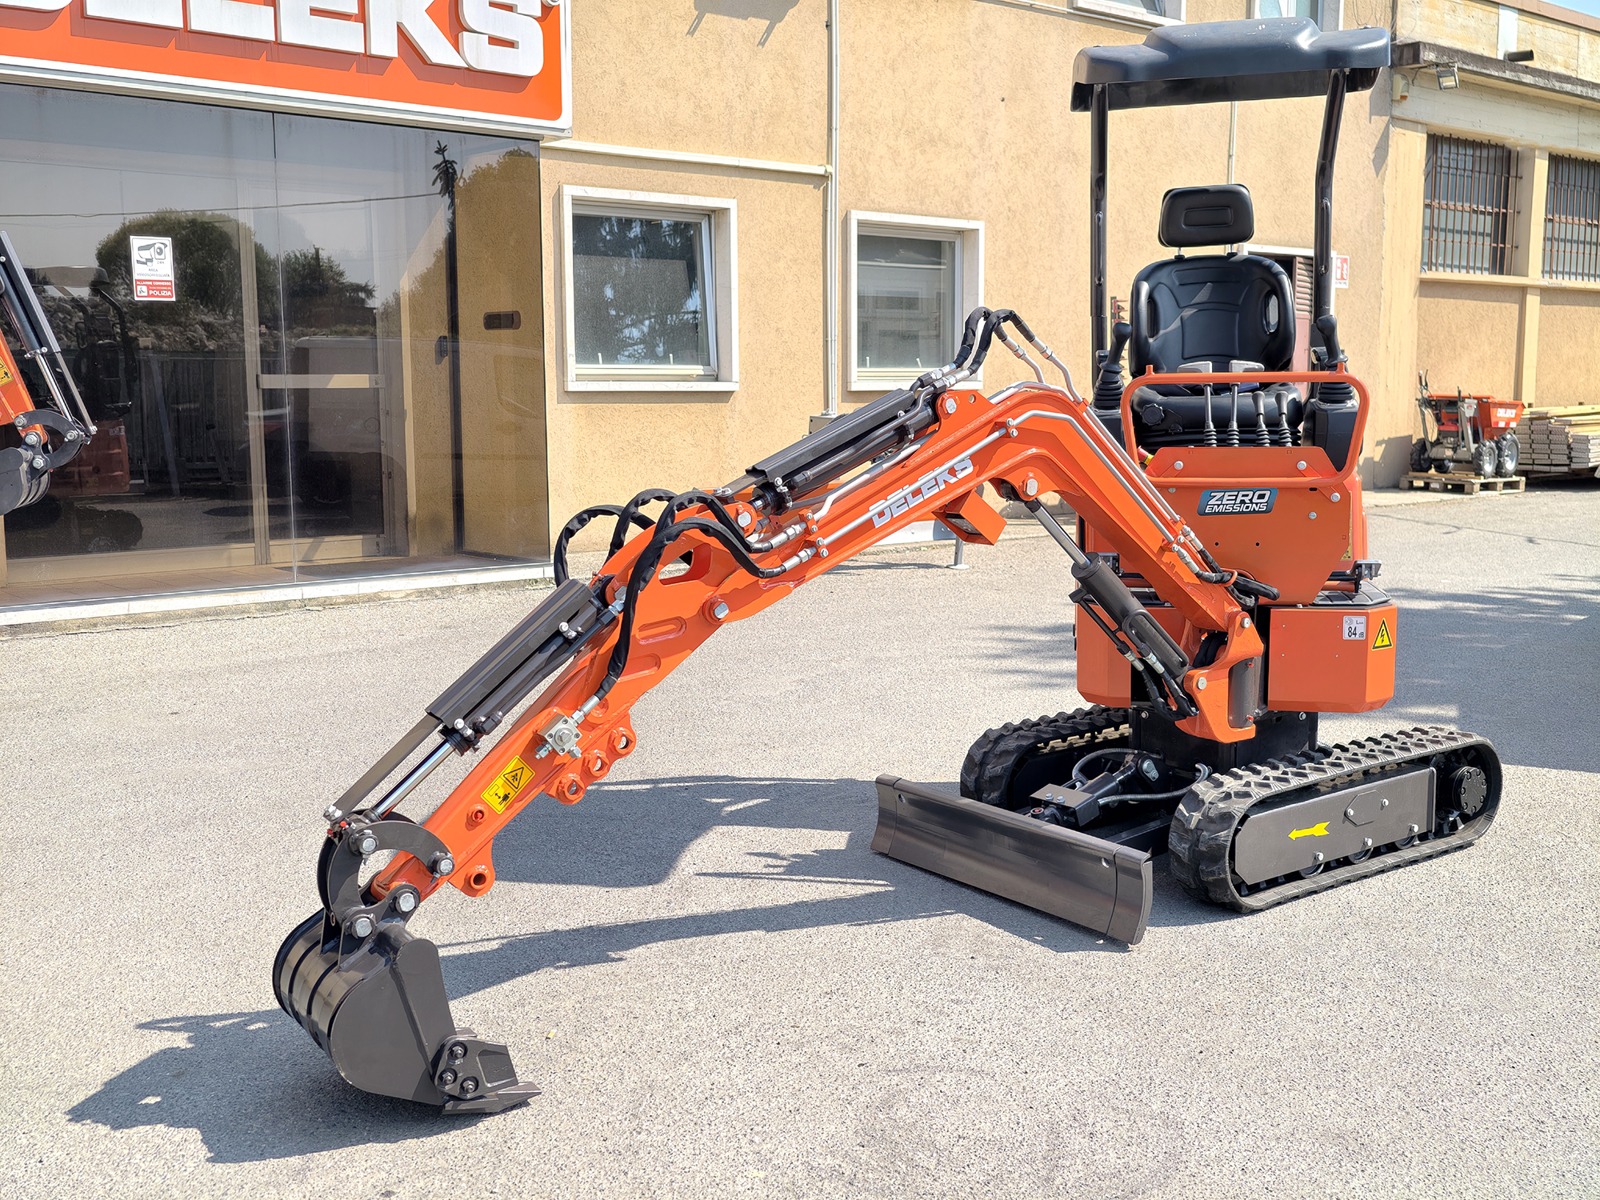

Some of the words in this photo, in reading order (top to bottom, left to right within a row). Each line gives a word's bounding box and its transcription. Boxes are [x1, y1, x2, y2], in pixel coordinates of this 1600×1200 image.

[1208, 491, 1270, 504] ZERO
[1205, 503, 1268, 513] EMISSIONS
[1348, 626, 1357, 638] 84
